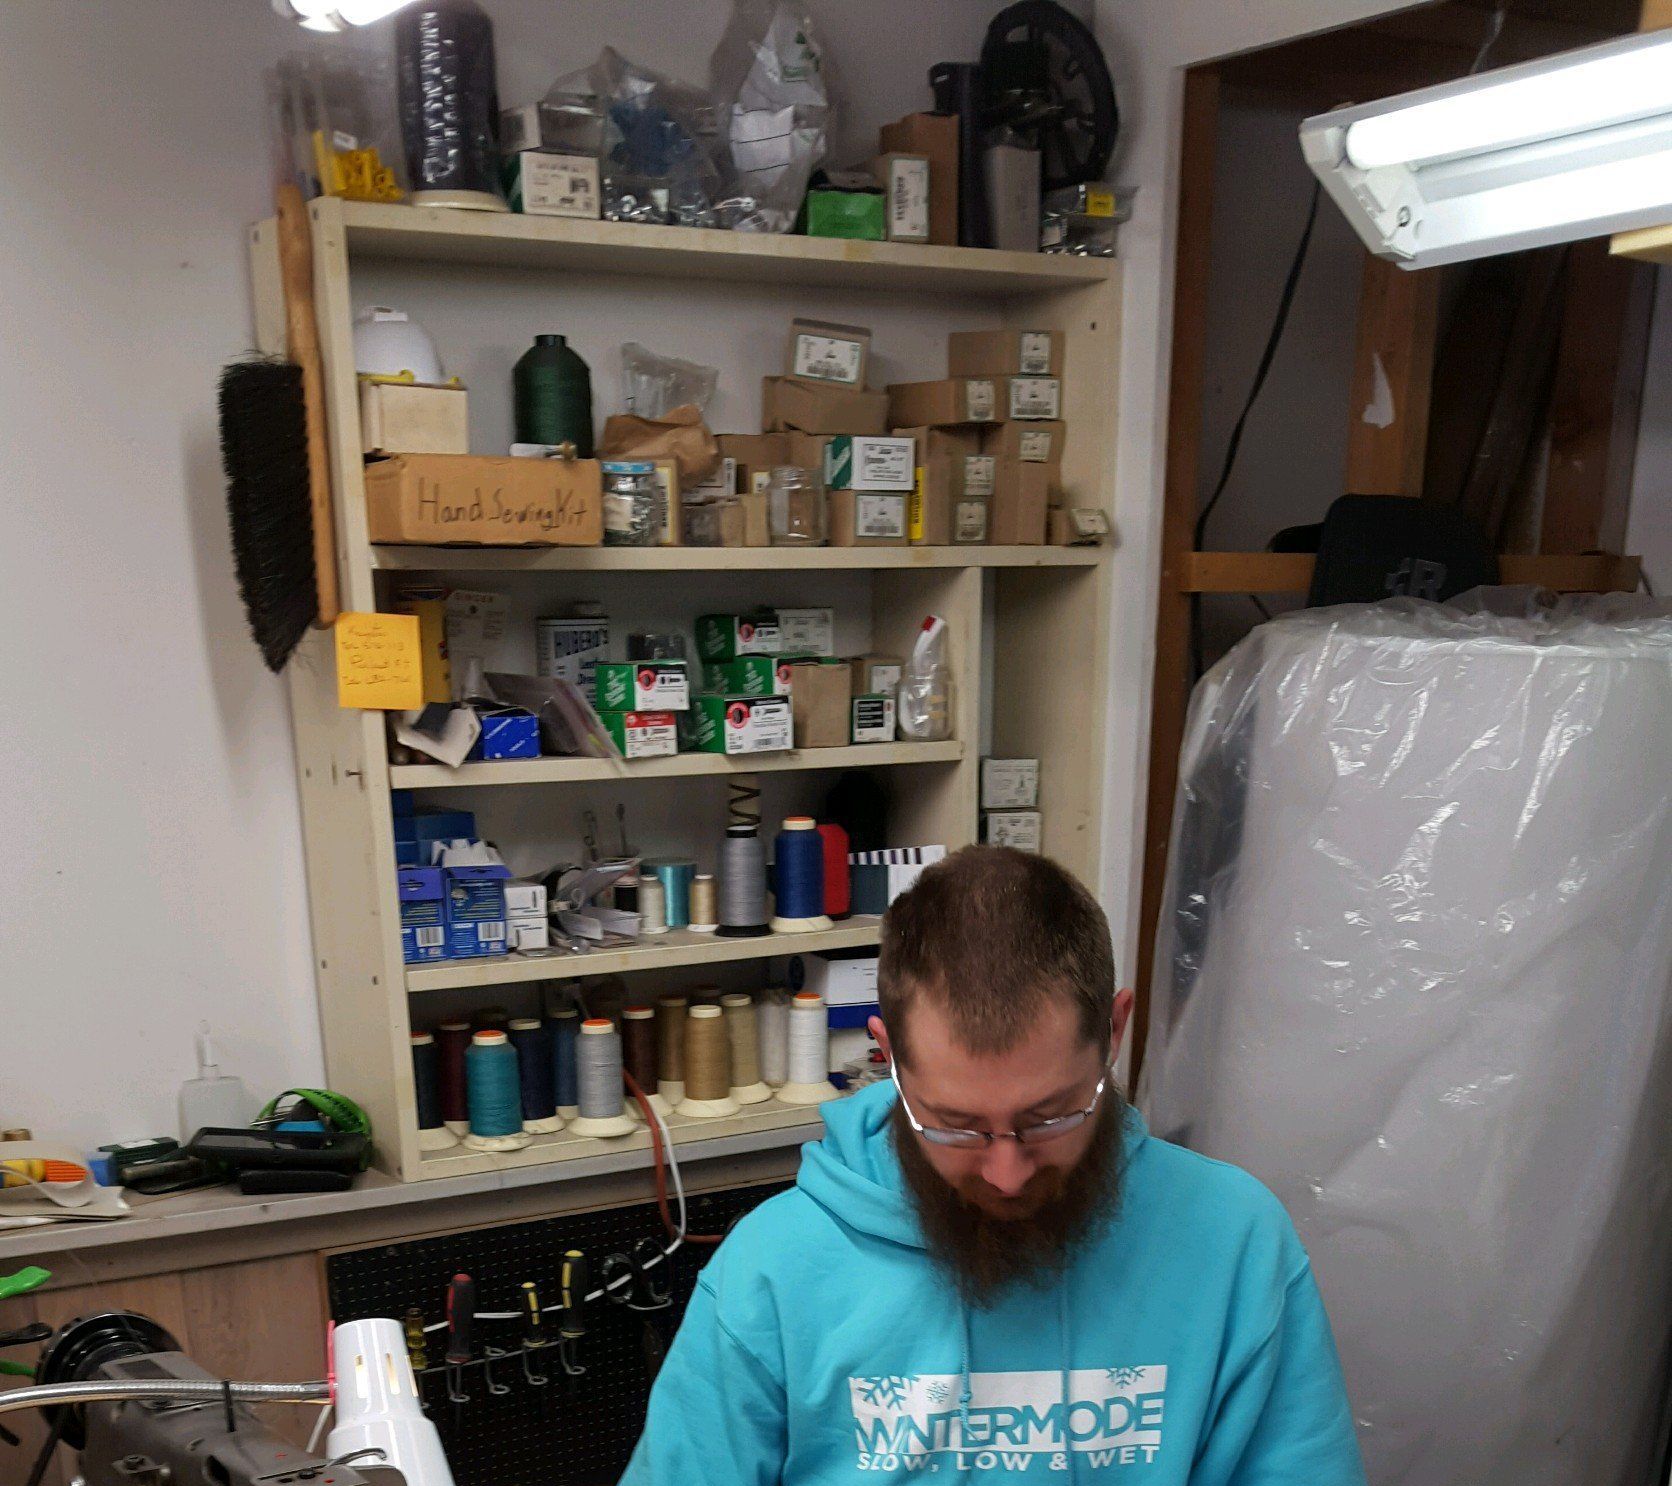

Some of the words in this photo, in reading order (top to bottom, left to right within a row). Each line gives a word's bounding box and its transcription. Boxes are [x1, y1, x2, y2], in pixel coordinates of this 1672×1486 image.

[418, 477, 484, 524] Hand
[488, 488, 557, 531] Sewing
[555, 488, 588, 527] Kit
[856, 1451, 939, 1472] SLOW,
[956, 1451, 1033, 1472] LOW
[1048, 1453, 1069, 1471] &
[1088, 1445, 1160, 1470] WET
